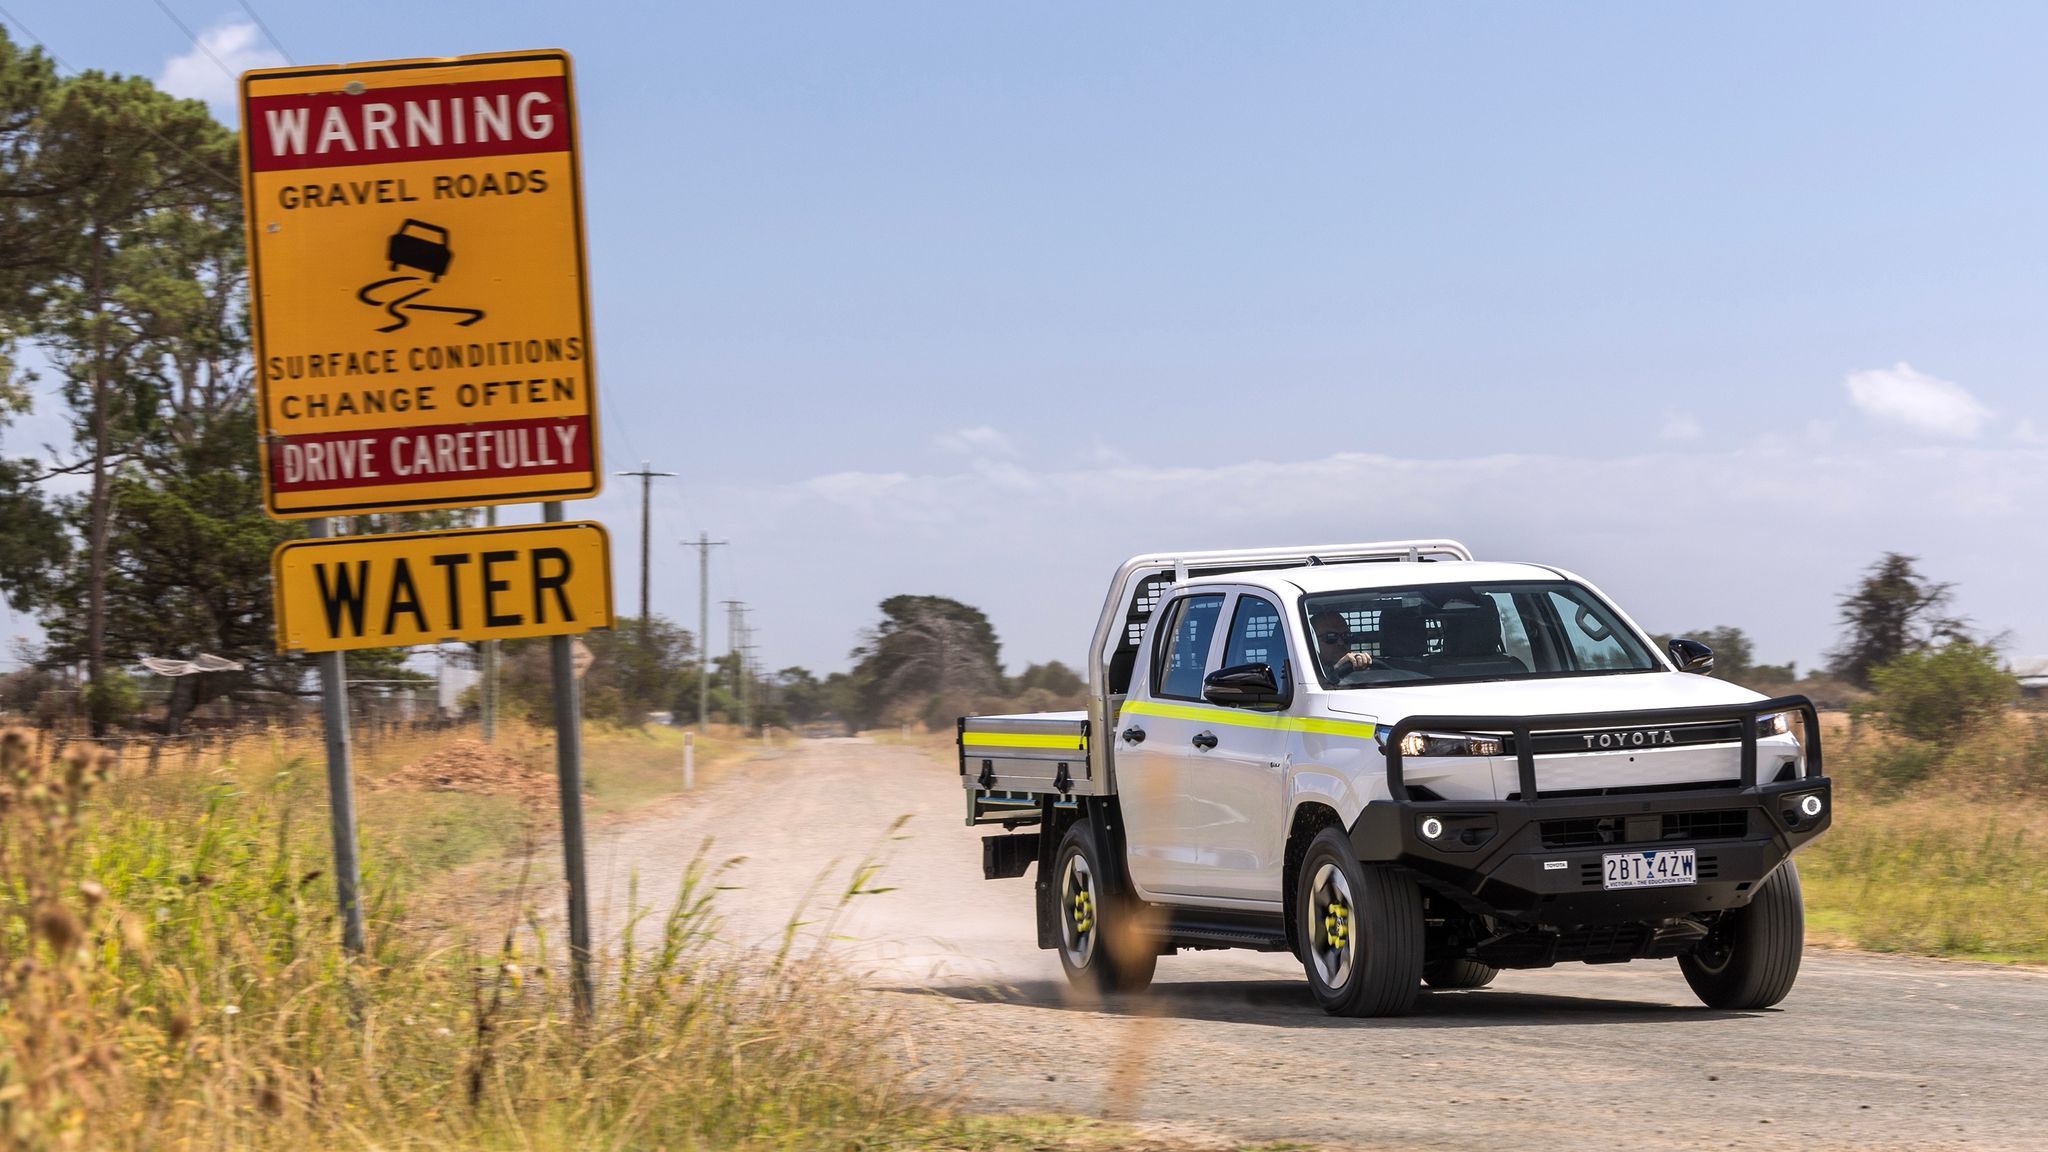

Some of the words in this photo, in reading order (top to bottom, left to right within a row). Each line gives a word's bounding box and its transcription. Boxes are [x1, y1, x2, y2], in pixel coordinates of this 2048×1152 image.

[265, 91, 554, 156] WARNING
[279, 179, 418, 210] GRAVEL
[434, 169, 549, 200] ROADS
[268, 349, 399, 381] SURFACE
[409, 337, 582, 371] CONDITIONS
[281, 386, 436, 419] CHANGE
[457, 377, 575, 408] OFTEN
[283, 438, 379, 484] DRIVE
[390, 425, 578, 477] CAREFULLY
[313, 547, 576, 639] WATER
[1583, 730, 1674, 748] TOYOTA
[1607, 858, 1641, 880] 2BT
[1658, 855, 1693, 877] 4ZW
